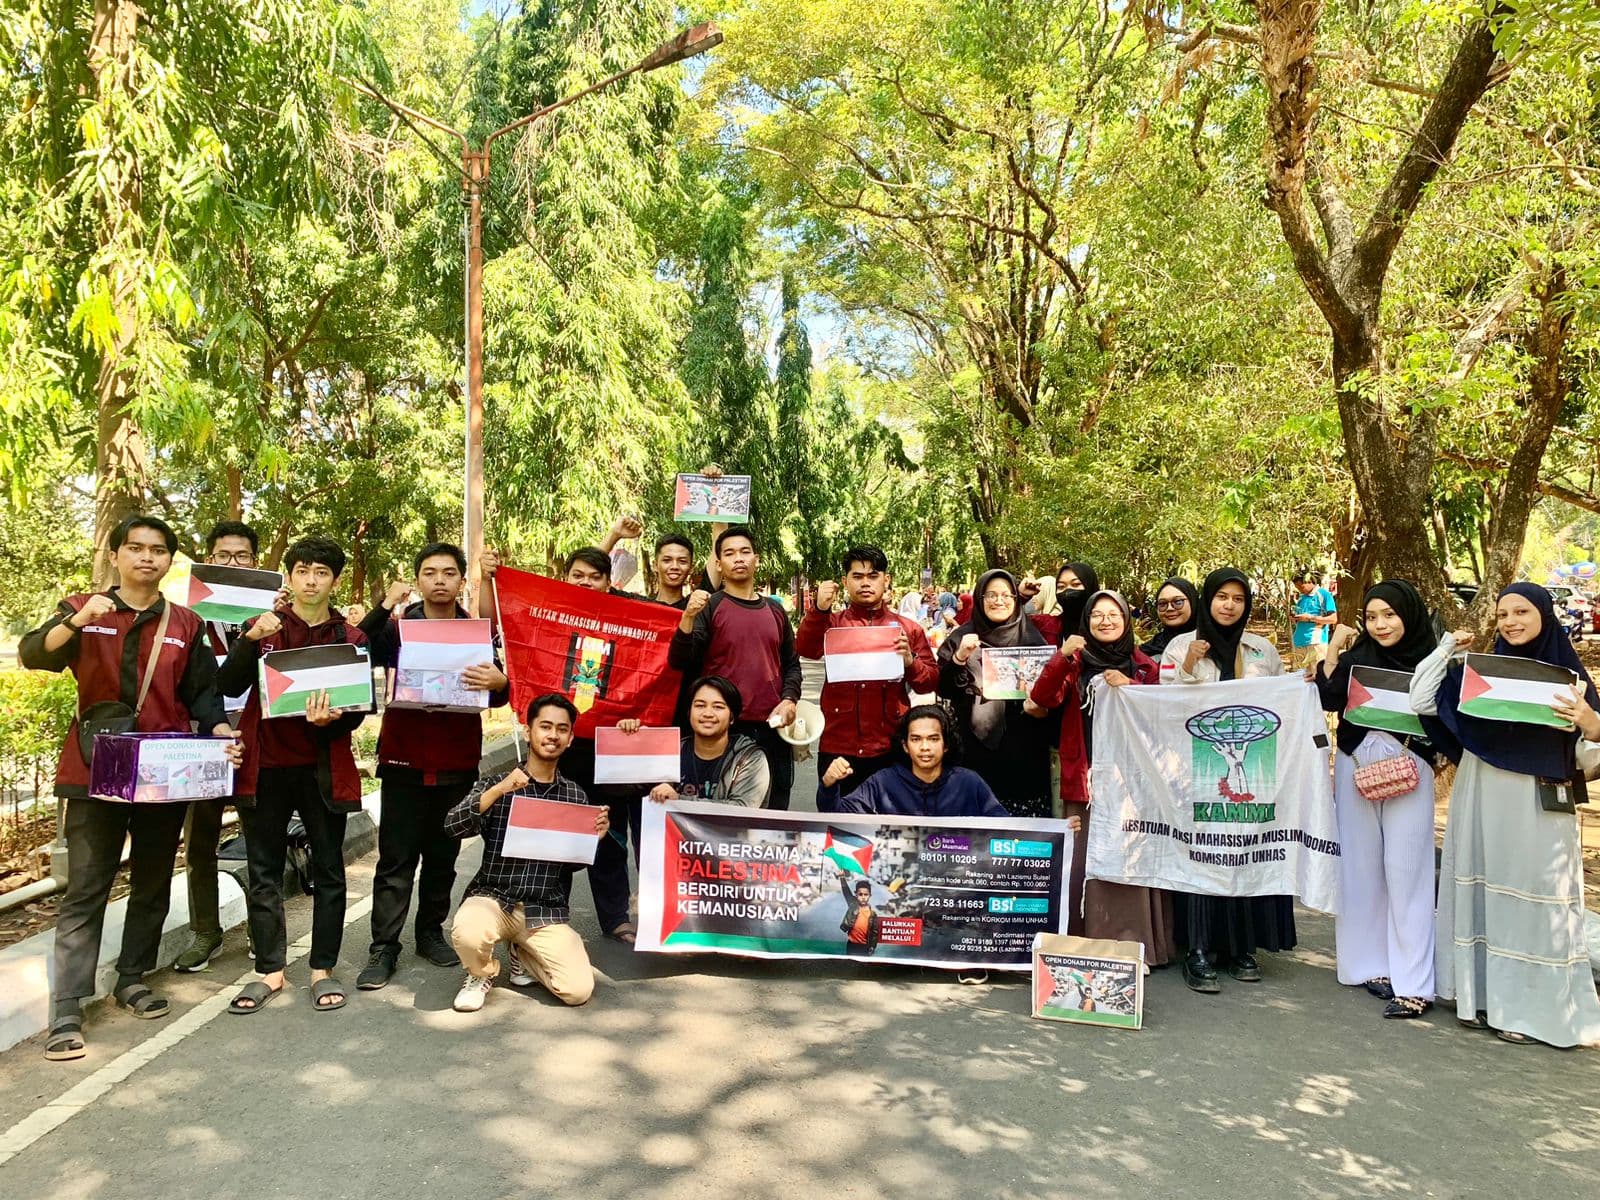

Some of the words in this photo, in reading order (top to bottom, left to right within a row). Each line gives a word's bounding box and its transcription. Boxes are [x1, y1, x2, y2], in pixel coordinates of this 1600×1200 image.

[529, 606, 557, 621] IKATAN
[558, 613, 601, 631] MAHASISWA
[602, 622, 658, 642] MUHAMMADIYAH
[575, 636, 611, 656] IMM
[144, 743, 165, 751] OPEN
[167, 742, 196, 750] DONASI
[163, 752, 203, 760] PALESTINA
[1193, 802, 1276, 824] KAMMI
[1122, 819, 1171, 836] KESATUAN
[1172, 827, 1193, 846] AKSI
[1195, 832, 1259, 848] MAHASISWA
[1261, 828, 1303, 844] MUSLIM
[679, 841, 713, 855] KITA
[718, 843, 801, 860] BERSAMA
[1189, 849, 1249, 866] KOMISARIAT
[1252, 848, 1286, 863] UNHAS
[920, 852, 947, 863] 80101
[950, 854, 978, 865] 10205
[991, 856, 1008, 867] 777
[1010, 858, 1021, 867] 77
[1024, 859, 1051, 869] 03026
[678, 857, 801, 883] PALESTINA
[678, 882, 738, 899] BERDIRI
[743, 886, 797, 902] UNTUK
[924, 897, 940, 907] 723
[943, 898, 955, 907] 58
[958, 899, 984, 909] 11663
[991, 899, 1013, 911] BSI
[678, 900, 798, 921] KEMANUSIAAN
[882, 920, 915, 928] SALURKAN
[981, 916, 1011, 924] KORKOM
[881, 934, 912, 942] MELALUI
[882, 927, 915, 935] BANTUAN
[1045, 956, 1062, 964] OPEN
[1062, 958, 1086, 967] DONASI
[1099, 963, 1134, 972] PALESTINE
